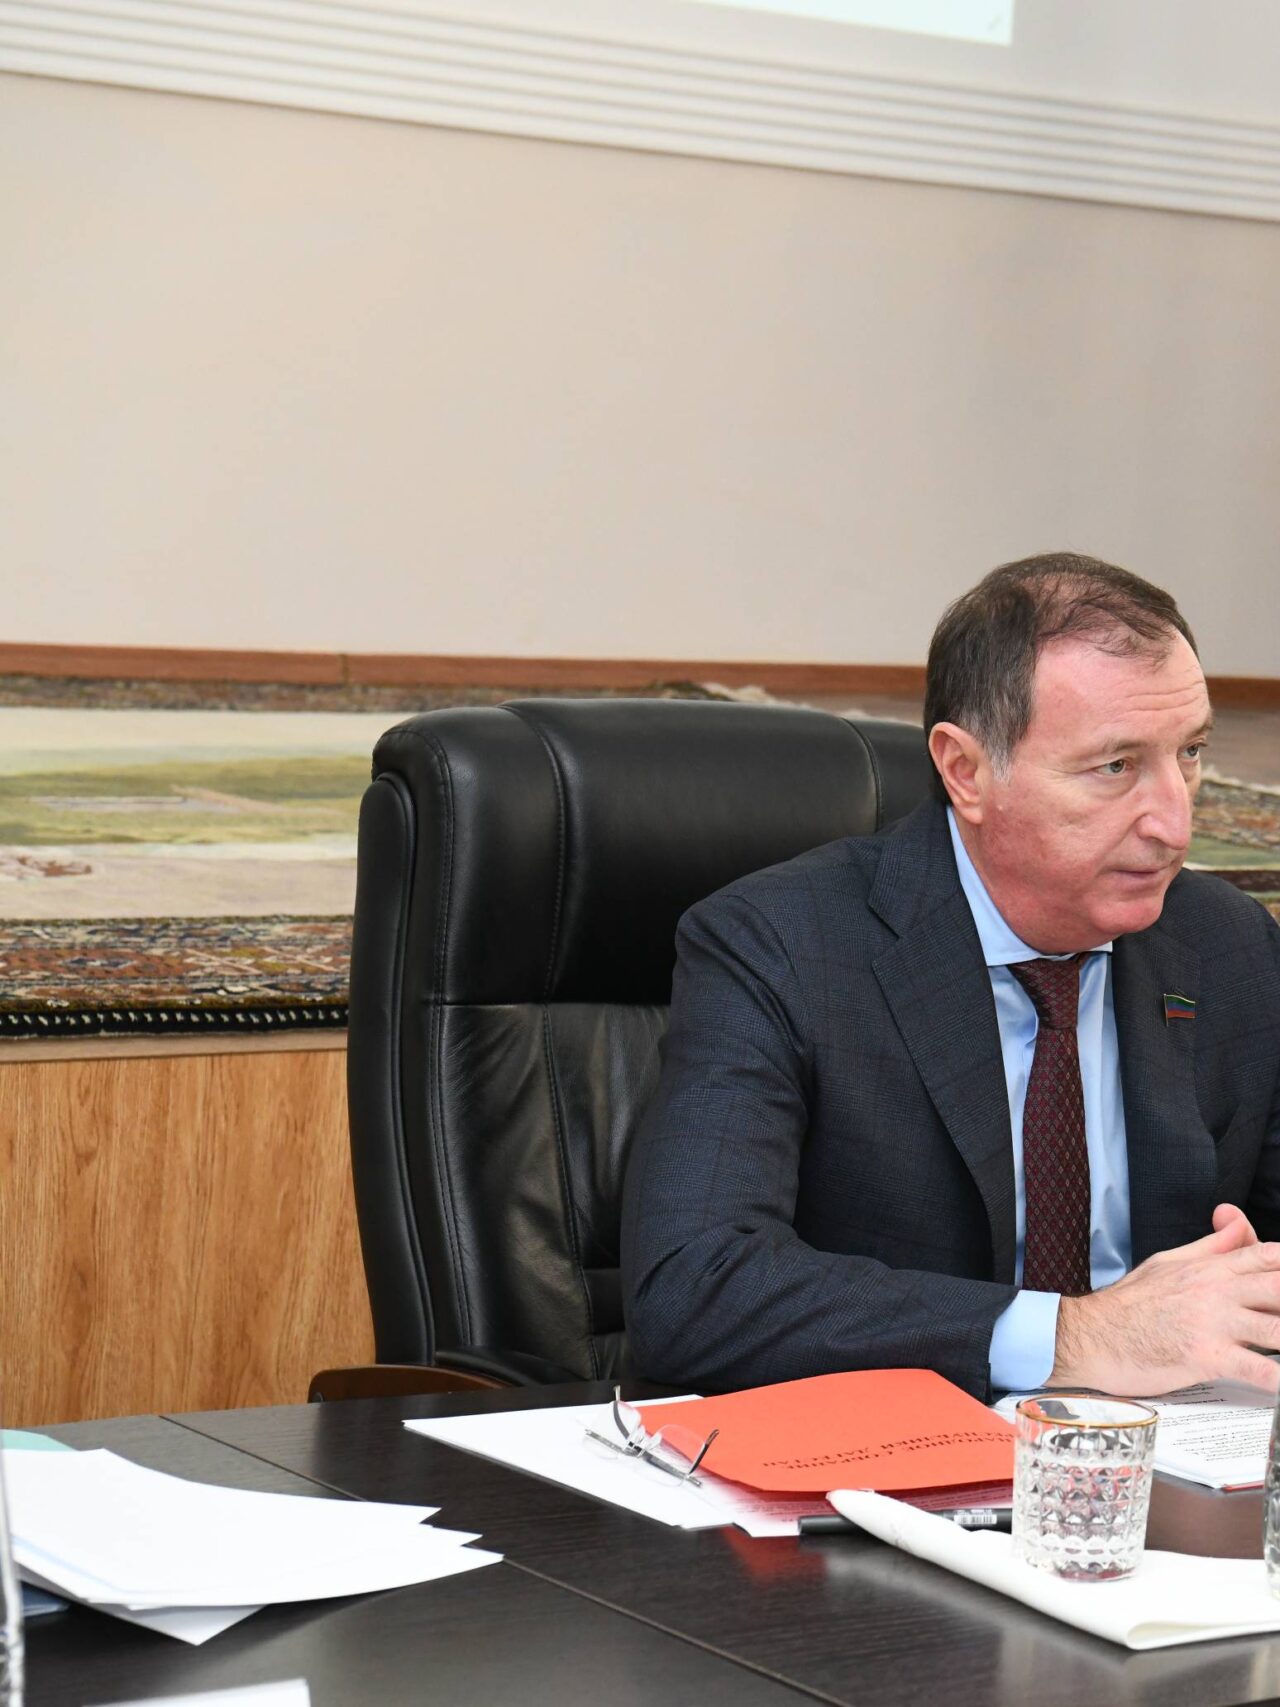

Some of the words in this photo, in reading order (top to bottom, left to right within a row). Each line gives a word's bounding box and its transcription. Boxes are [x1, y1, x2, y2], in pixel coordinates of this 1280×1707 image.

[907, 1437, 1013, 1451] НАРОДНОЕ
[763, 1448, 870, 1466] ДАГЕСТАН
[786, 1451, 893, 1469] СОБРАНИЕ
